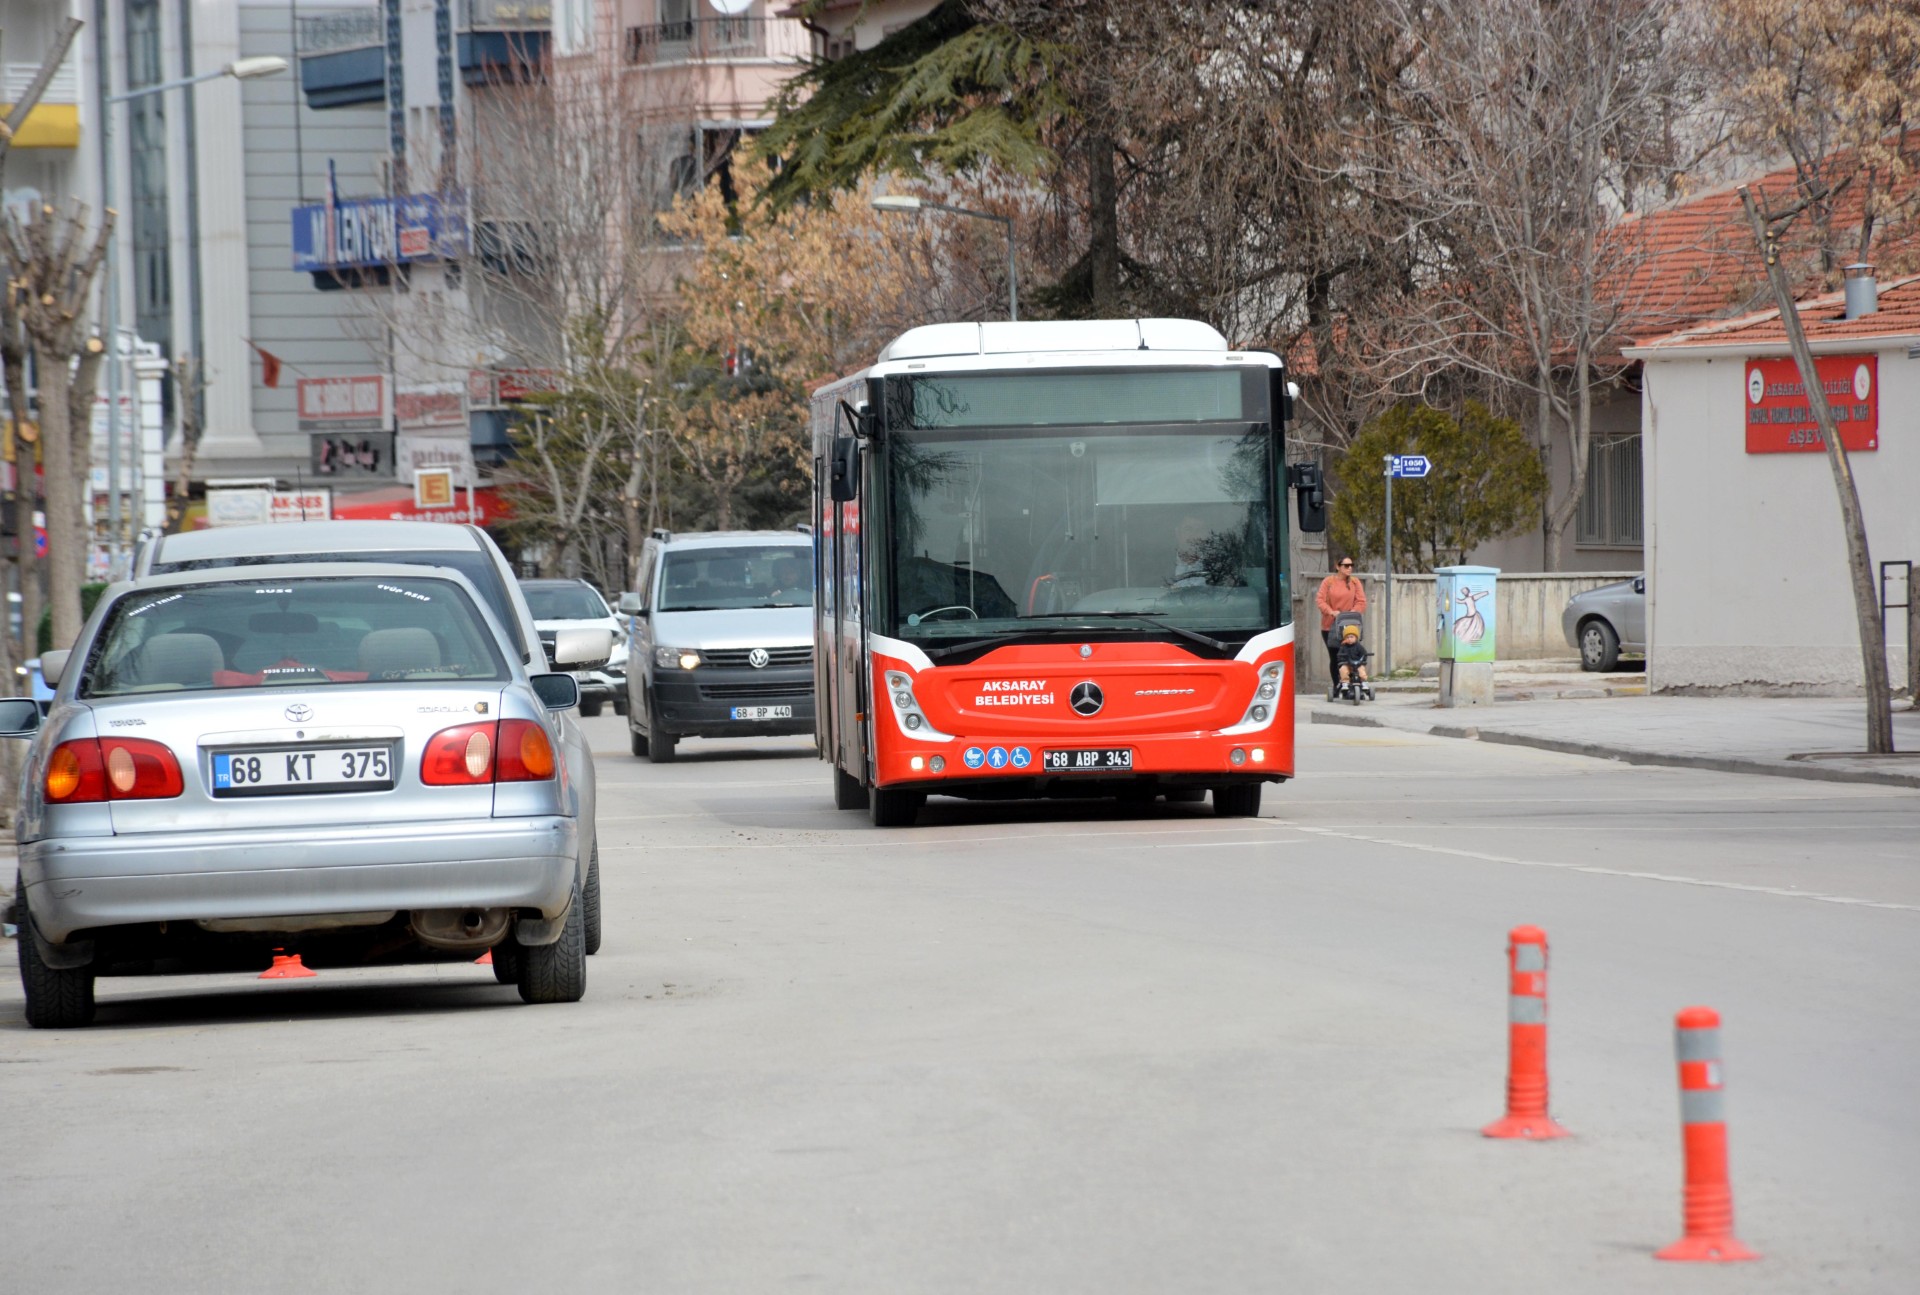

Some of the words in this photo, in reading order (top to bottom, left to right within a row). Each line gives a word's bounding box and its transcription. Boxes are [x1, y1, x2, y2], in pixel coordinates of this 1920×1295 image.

[1766, 383, 1805, 396] AKSARAY
[1822, 376, 1852, 394] LİLİĞİ
[1788, 429, 1824, 448] AŞEV
[425, 478, 444, 499] E
[982, 680, 1047, 692] AKSARAY
[975, 692, 1054, 706] BELEDİYESİ
[417, 705, 470, 713] COROLLA
[736, 708, 748, 718] 68
[757, 707, 768, 718] BP
[774, 706, 791, 717] 440
[109, 718, 146, 728] TOYOTA
[1052, 752, 1068, 767] 68
[1075, 751, 1099, 767] ABP
[1106, 751, 1130, 766] 343
[217, 773, 229, 782] TR
[230, 757, 262, 784] 68
[286, 753, 316, 781] KT
[341, 750, 388, 779] 375
